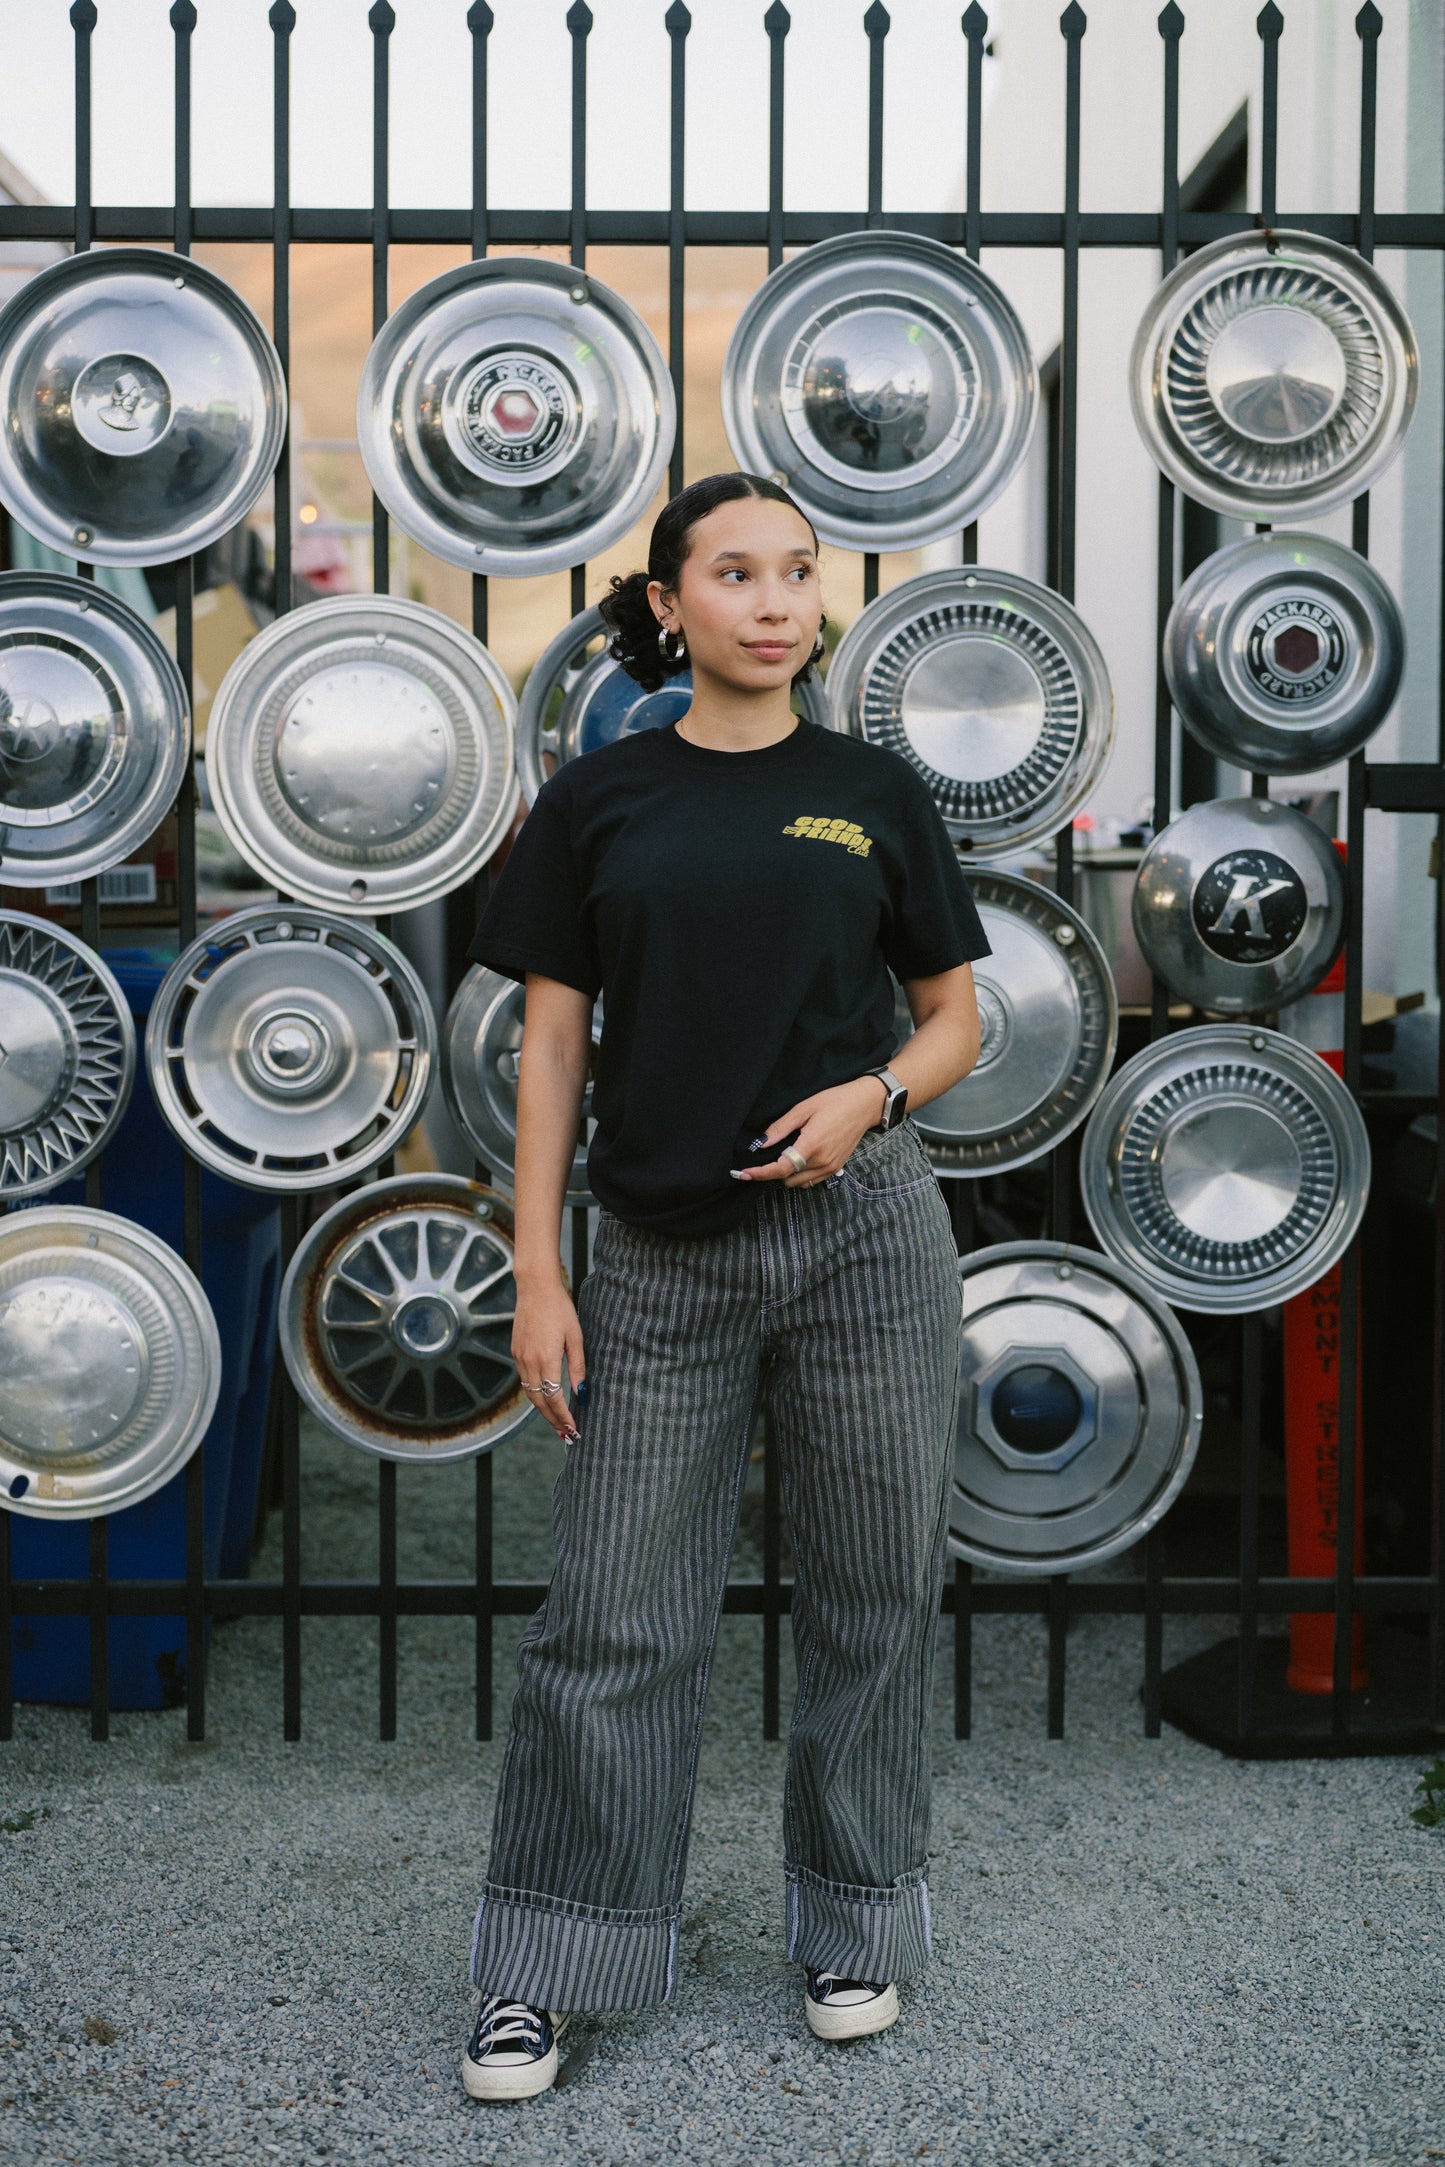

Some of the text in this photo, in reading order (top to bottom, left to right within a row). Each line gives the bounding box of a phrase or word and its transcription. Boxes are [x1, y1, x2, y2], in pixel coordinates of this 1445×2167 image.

[1256, 602, 1332, 631] PACKARD
[1260, 669, 1335, 698] PACKARD
[782, 825, 873, 851] FRIENDS
[794, 816, 864, 834] GOOD
[1207, 873, 1294, 939] K
